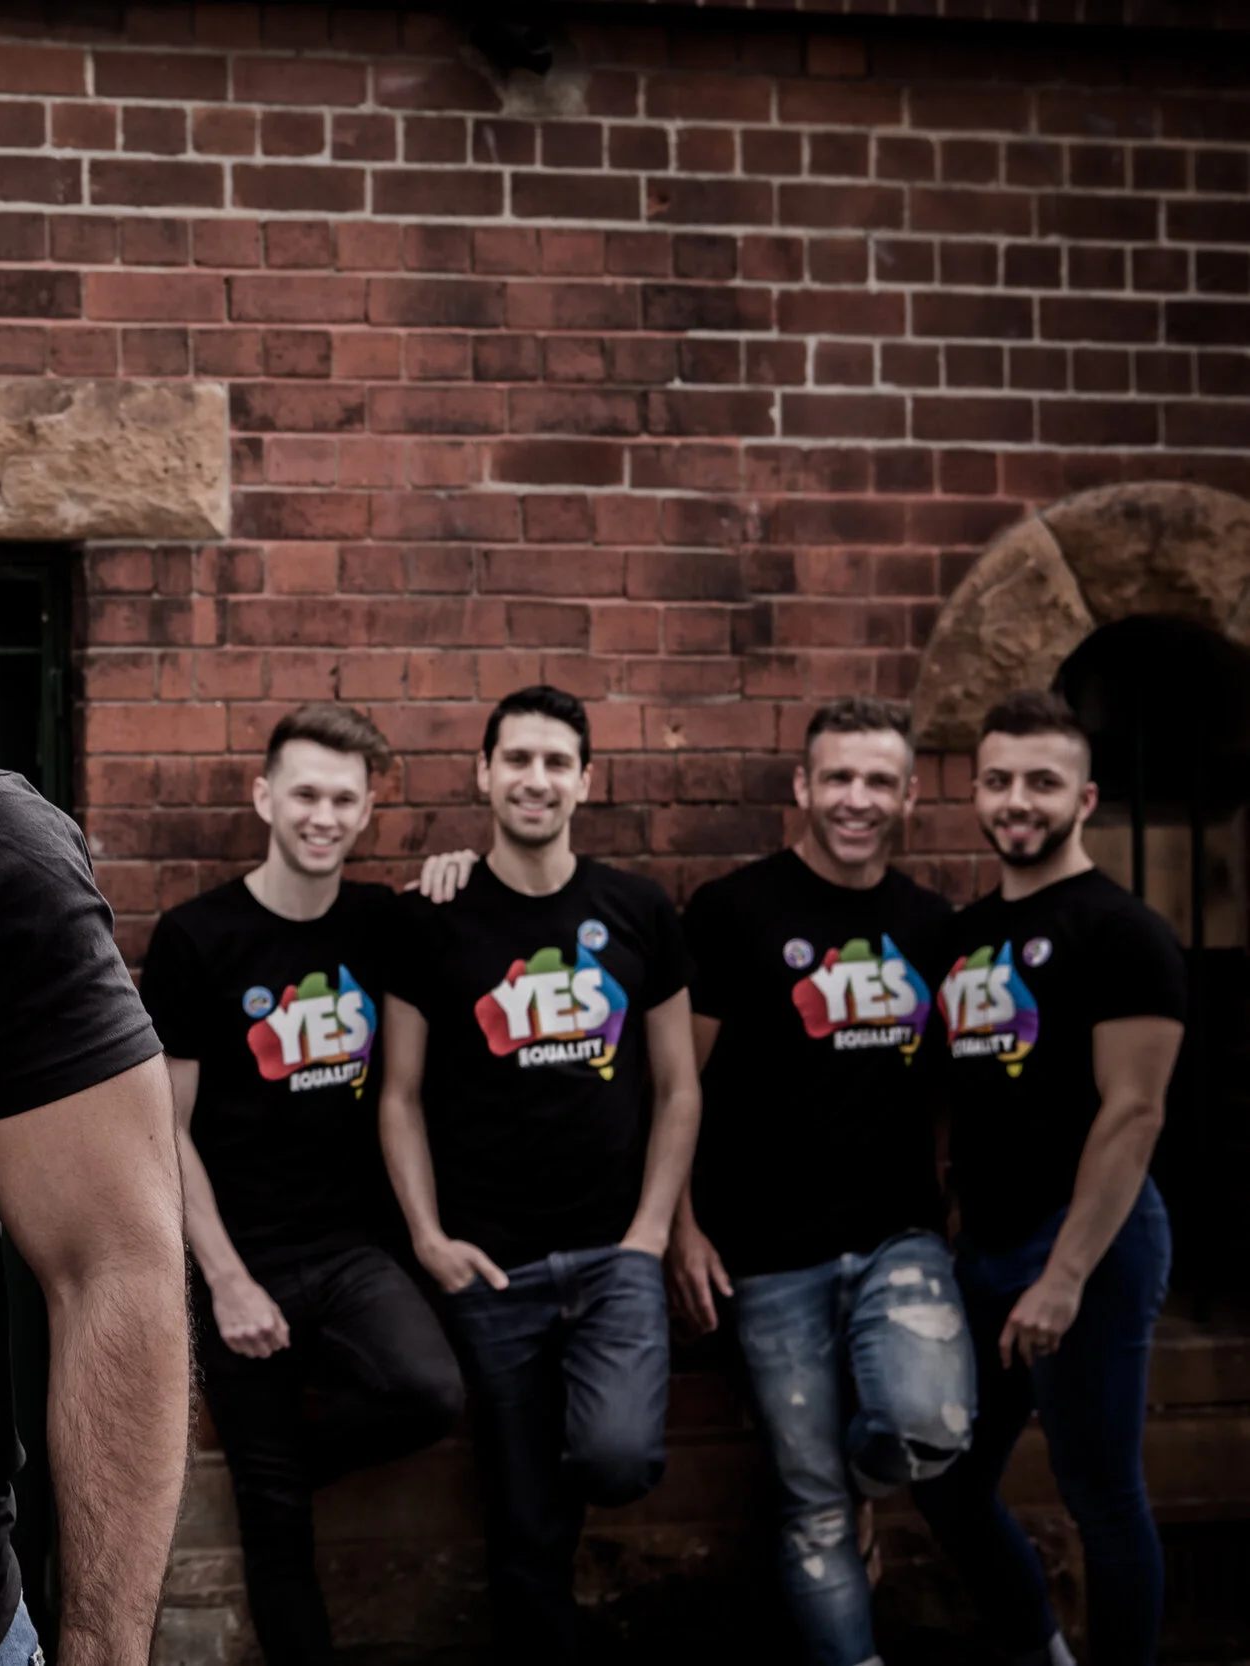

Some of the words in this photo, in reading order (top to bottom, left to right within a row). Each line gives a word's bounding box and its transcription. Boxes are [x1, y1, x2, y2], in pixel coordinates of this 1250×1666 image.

[491, 968, 610, 1040] YES
[810, 958, 917, 1023] YES
[941, 964, 1015, 1031] YES
[267, 991, 368, 1065] YES
[519, 1038, 603, 1067] EQUALITY
